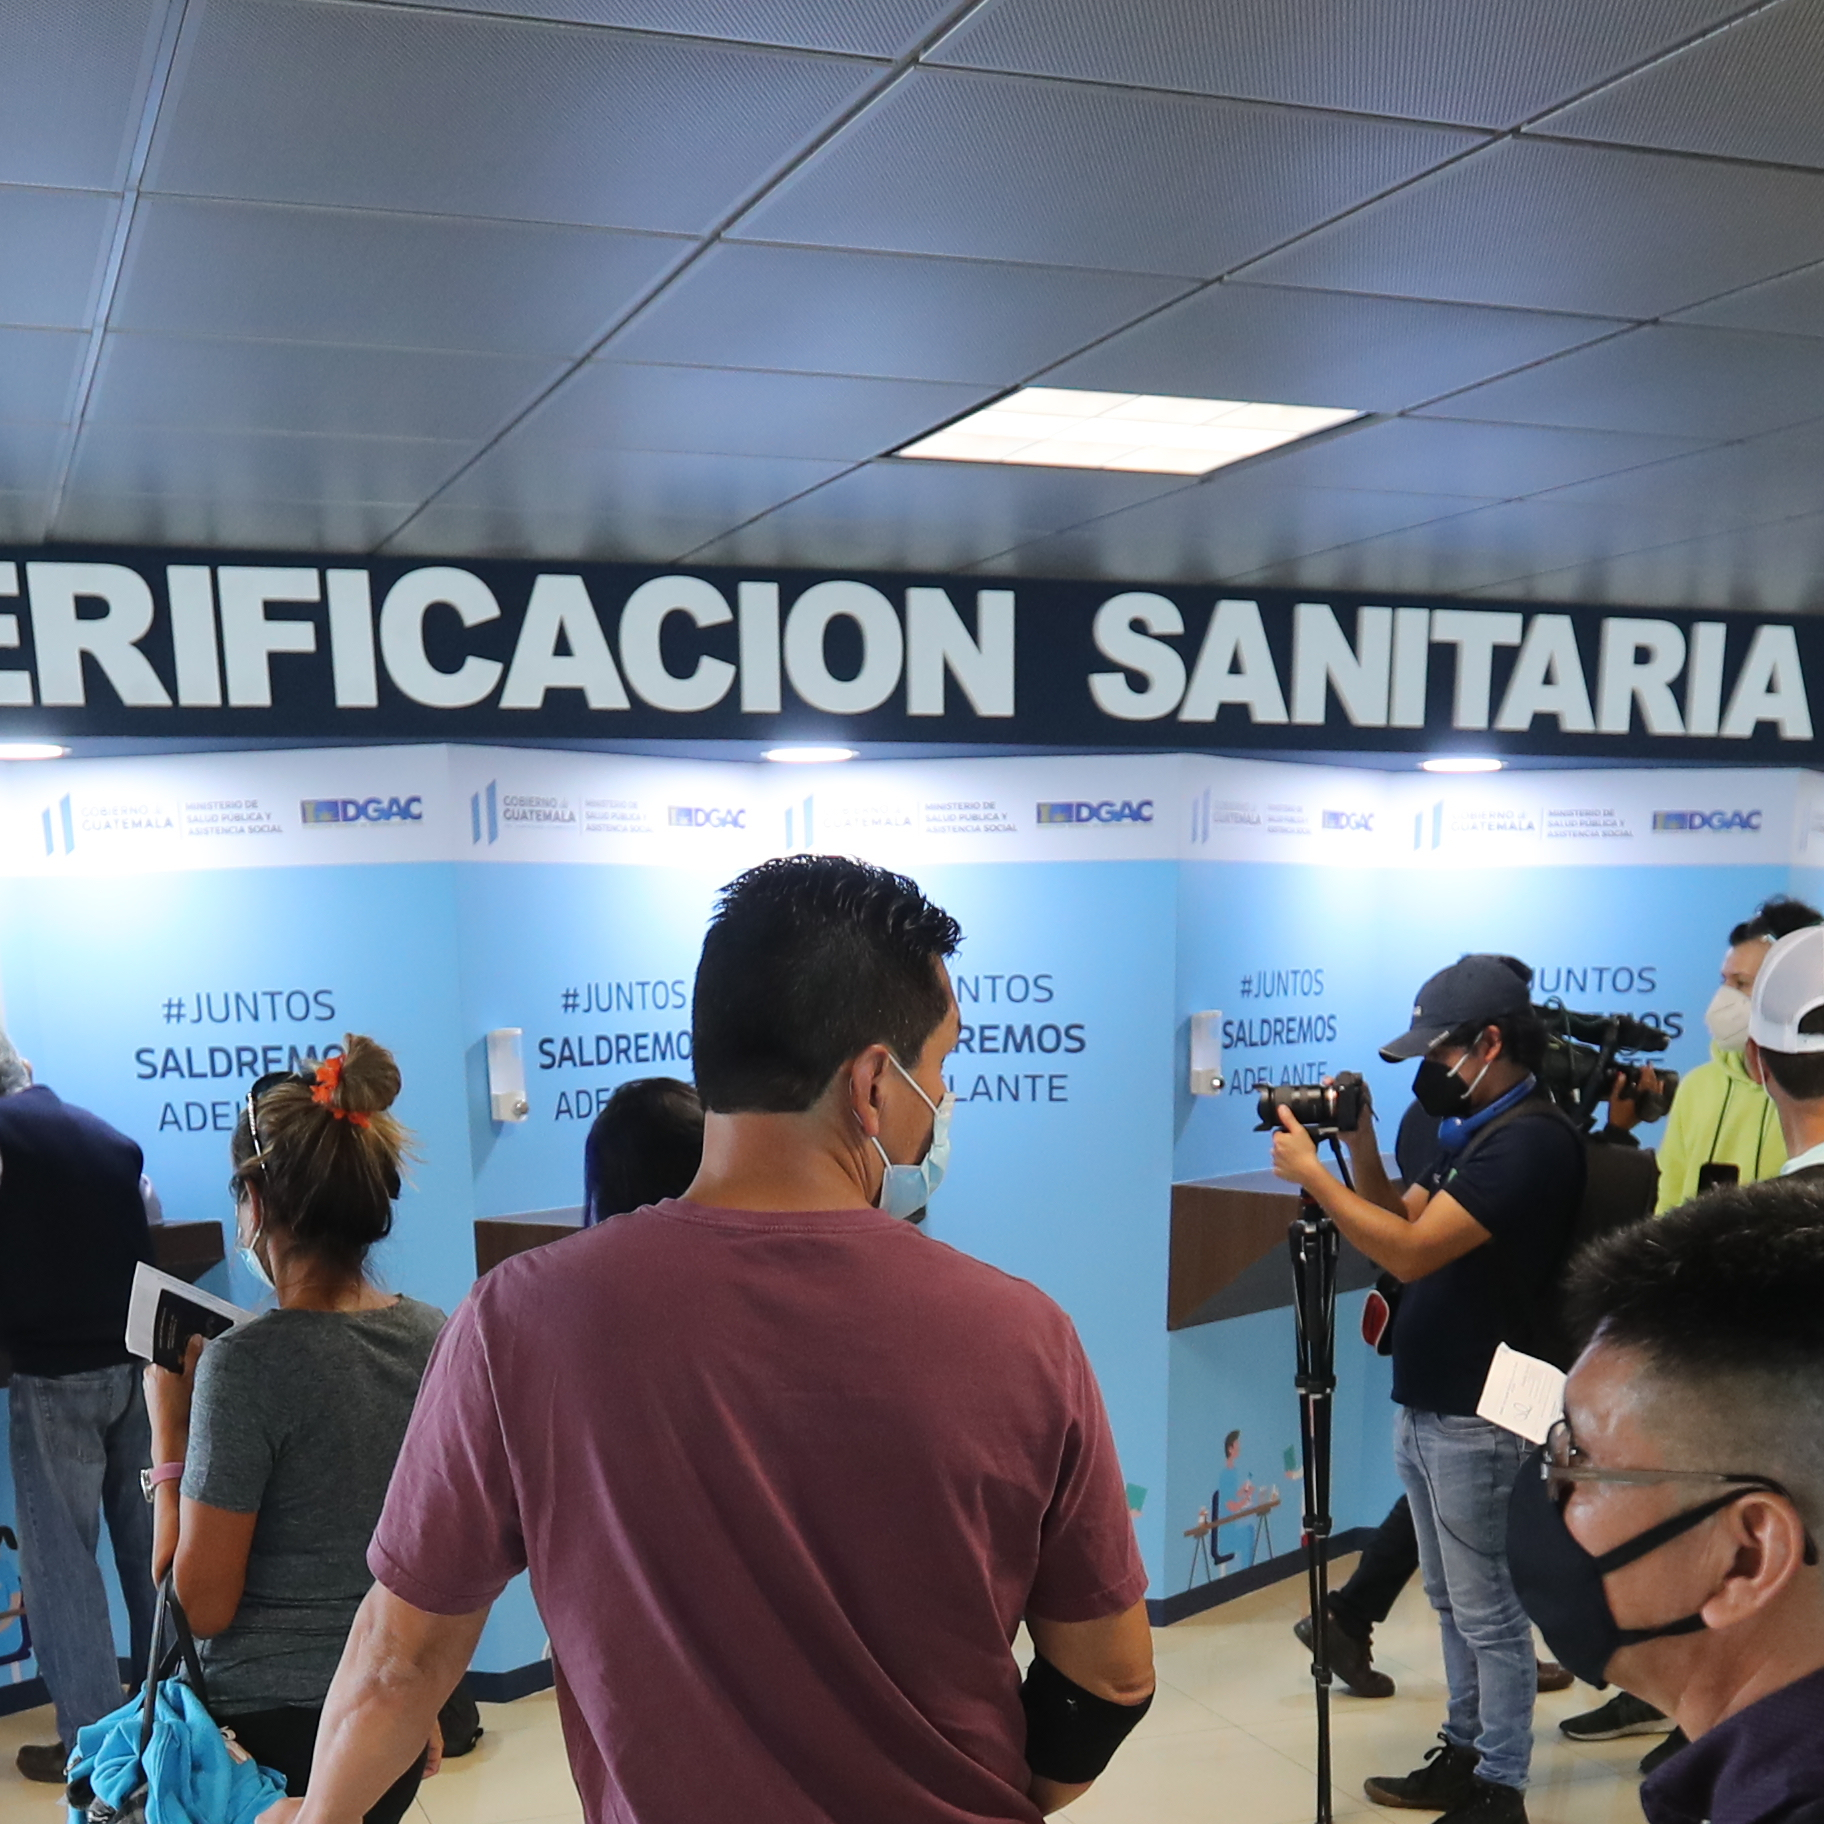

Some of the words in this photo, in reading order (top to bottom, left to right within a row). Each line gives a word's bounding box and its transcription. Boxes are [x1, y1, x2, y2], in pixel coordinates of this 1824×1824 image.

[1088, 592, 1814, 740] SANITARIA
[341, 796, 423, 821] DGAC
[503, 808, 575, 823] GUATEMALA
[694, 808, 746, 829] DGAC
[1075, 800, 1154, 823] DGAC
[1687, 810, 1762, 831] DGAC
[560, 979, 688, 1014] #JUNTOS
[956, 973, 1054, 1004] NTOS
[1240, 968, 1325, 999] #JUNTOS
[161, 988, 337, 1025] #JUNTOS
[1221, 1013, 1338, 1050] SALDREMOS
[943, 1073, 1069, 1102] LANTE
